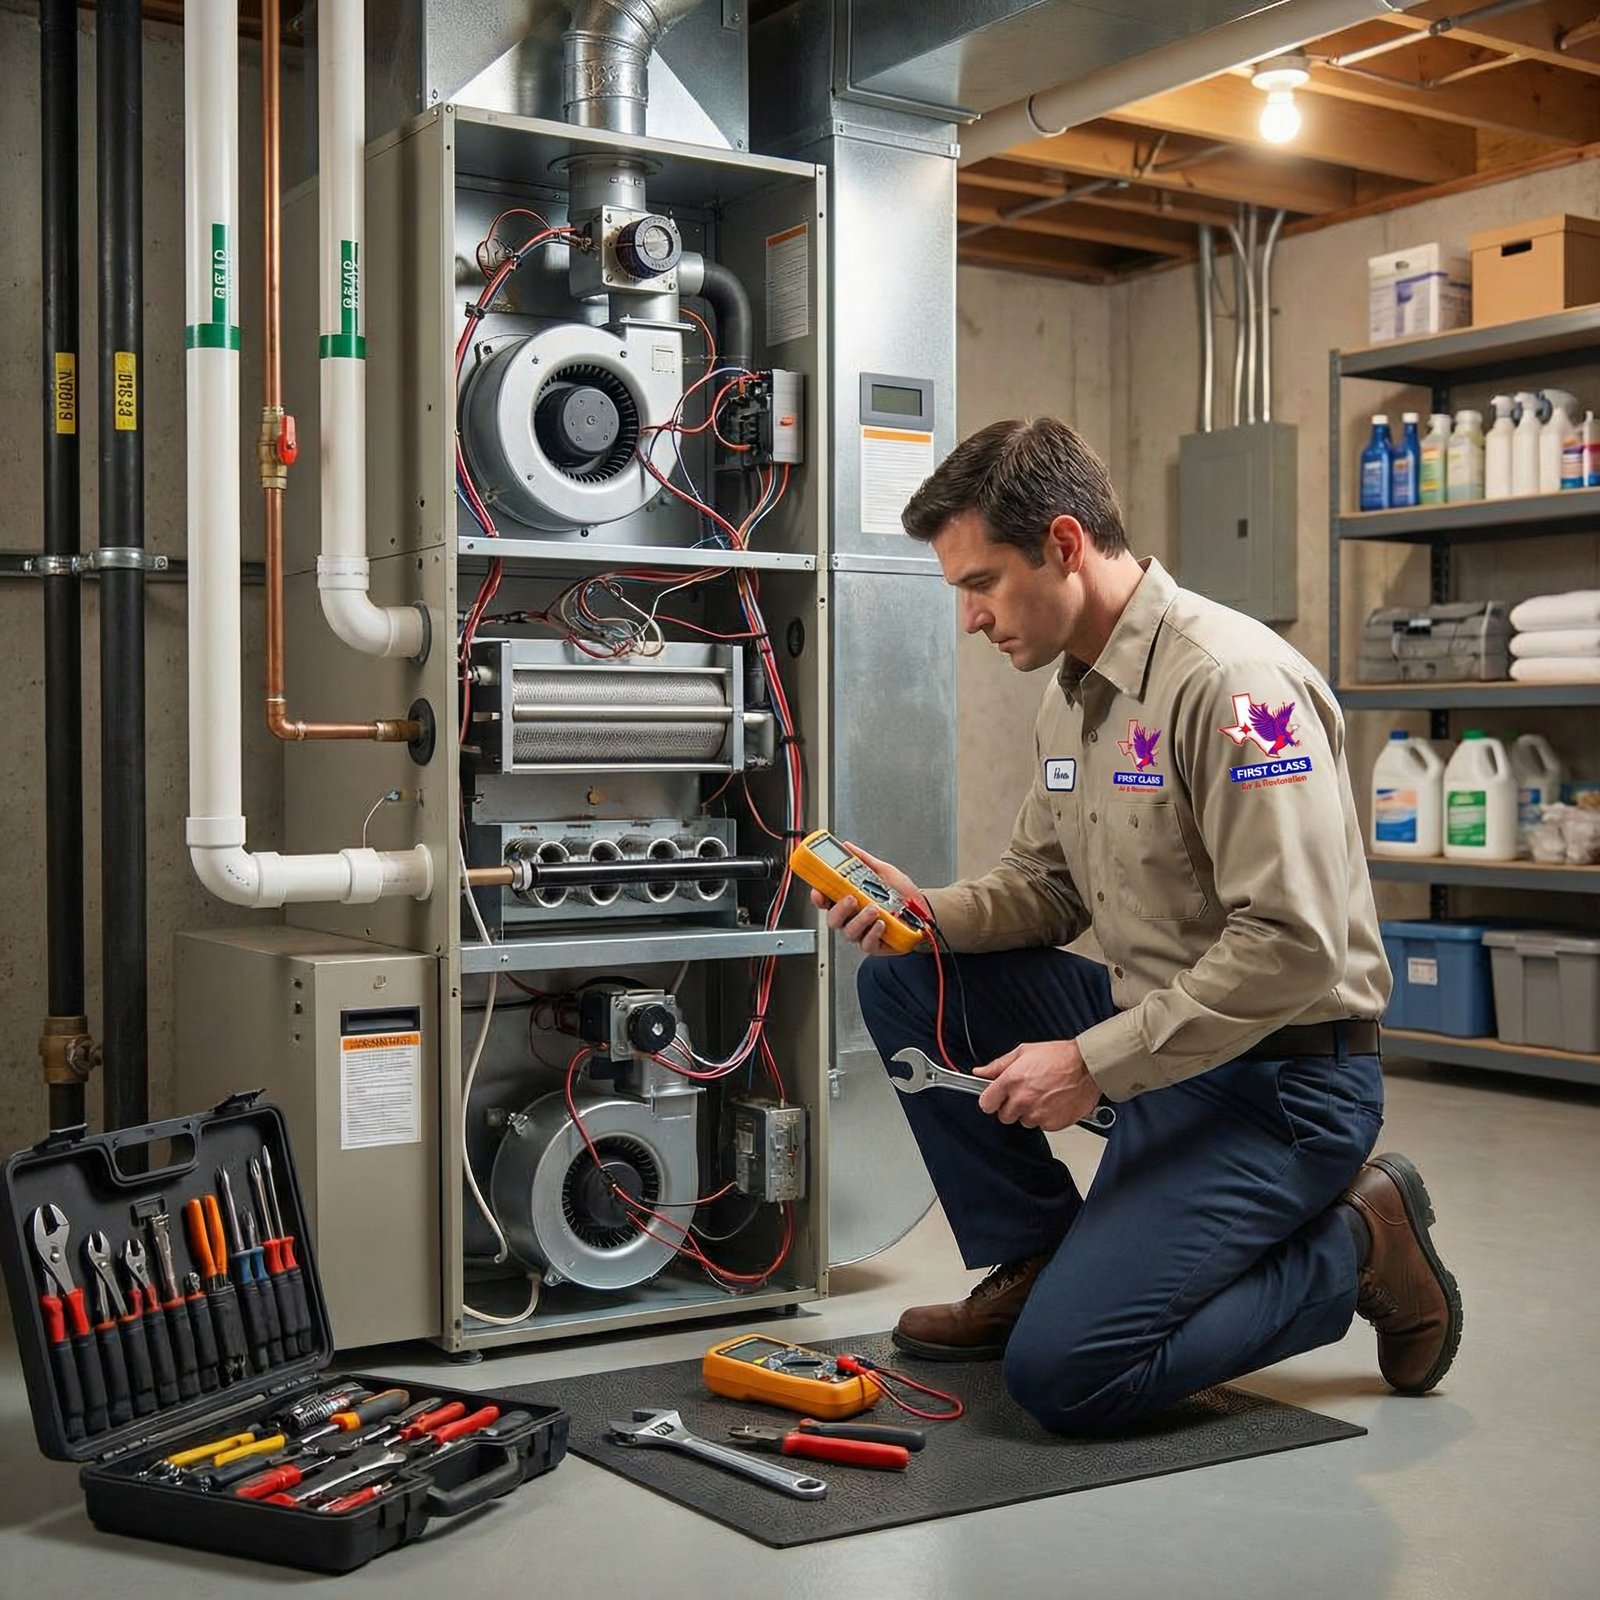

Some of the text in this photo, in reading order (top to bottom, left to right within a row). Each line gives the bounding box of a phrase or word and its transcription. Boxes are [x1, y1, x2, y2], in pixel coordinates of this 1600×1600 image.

[1236, 760, 1307, 780] FIRST CLASS
[1117, 774, 1161, 785] FIRST CLASS
